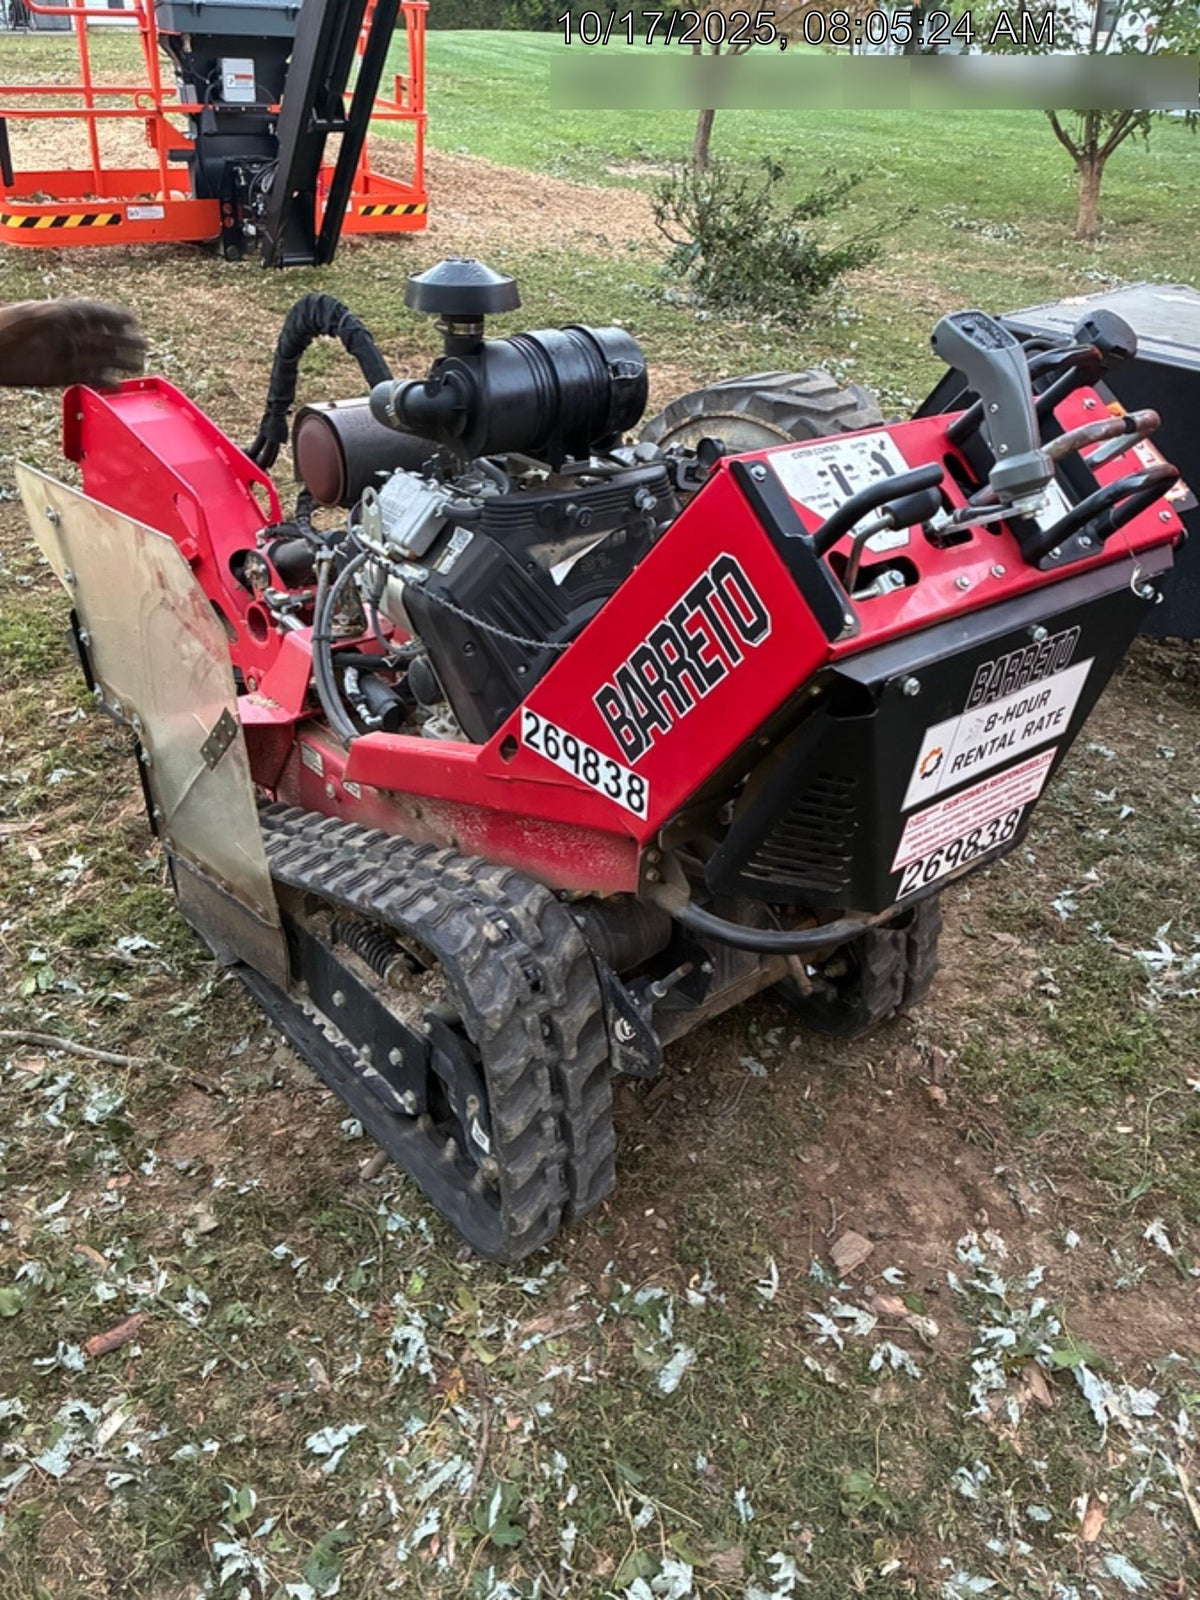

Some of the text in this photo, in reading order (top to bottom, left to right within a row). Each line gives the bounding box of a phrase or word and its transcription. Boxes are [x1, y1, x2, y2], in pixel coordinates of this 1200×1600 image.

[592, 551, 772, 766] BARRETO
[963, 625, 1081, 714] BARRETO
[951, 705, 1066, 774] RENTAL RATE
[983, 688, 1052, 733] 8-HOUR
[523, 711, 646, 814] 269838
[898, 807, 1021, 895] 269838
